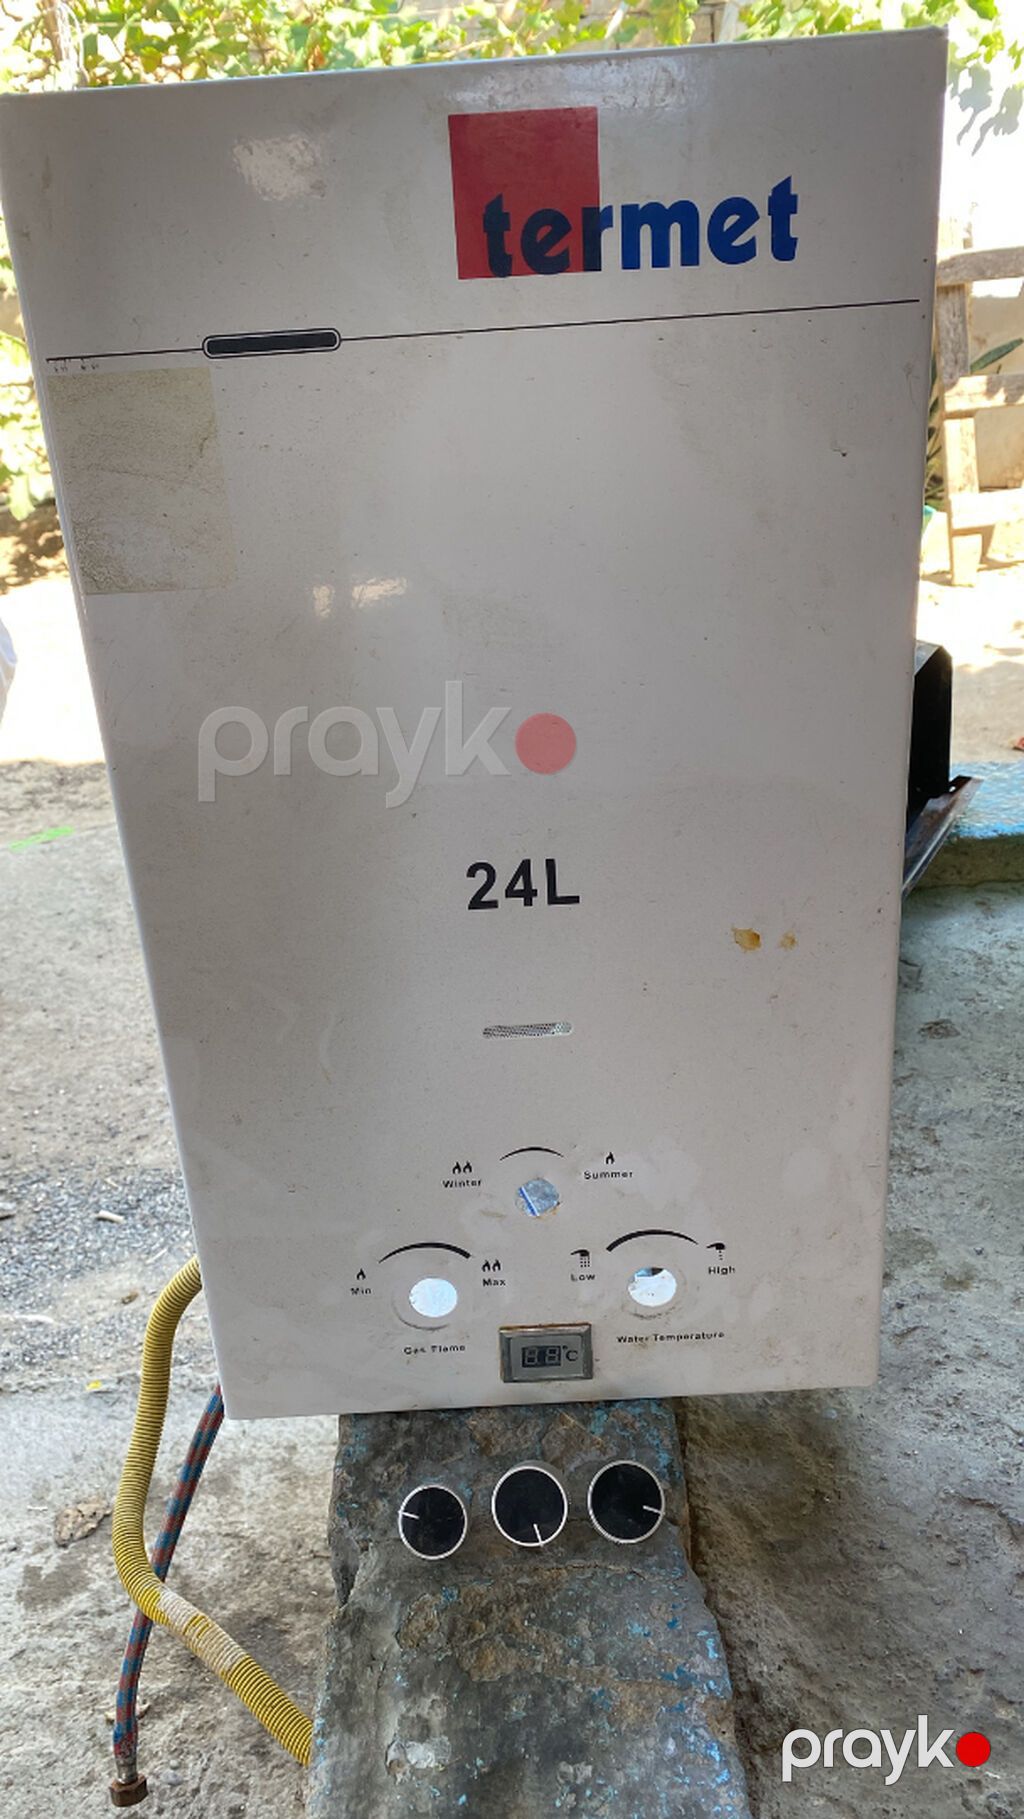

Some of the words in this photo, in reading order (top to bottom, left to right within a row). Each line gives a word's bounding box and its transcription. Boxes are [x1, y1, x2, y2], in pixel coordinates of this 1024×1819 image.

[483, 175, 798, 278] termet
[466, 858, 580, 910] 24L
[583, 1170, 634, 1180] Summer
[442, 1179, 482, 1189] Winter
[708, 1265, 736, 1276] High
[482, 1277, 507, 1288] Max
[570, 1273, 596, 1283] Low
[350, 1286, 372, 1296] Min
[617, 1334, 650, 1344] Water
[653, 1331, 725, 1343] Temperature
[403, 1345, 427, 1356] Gas
